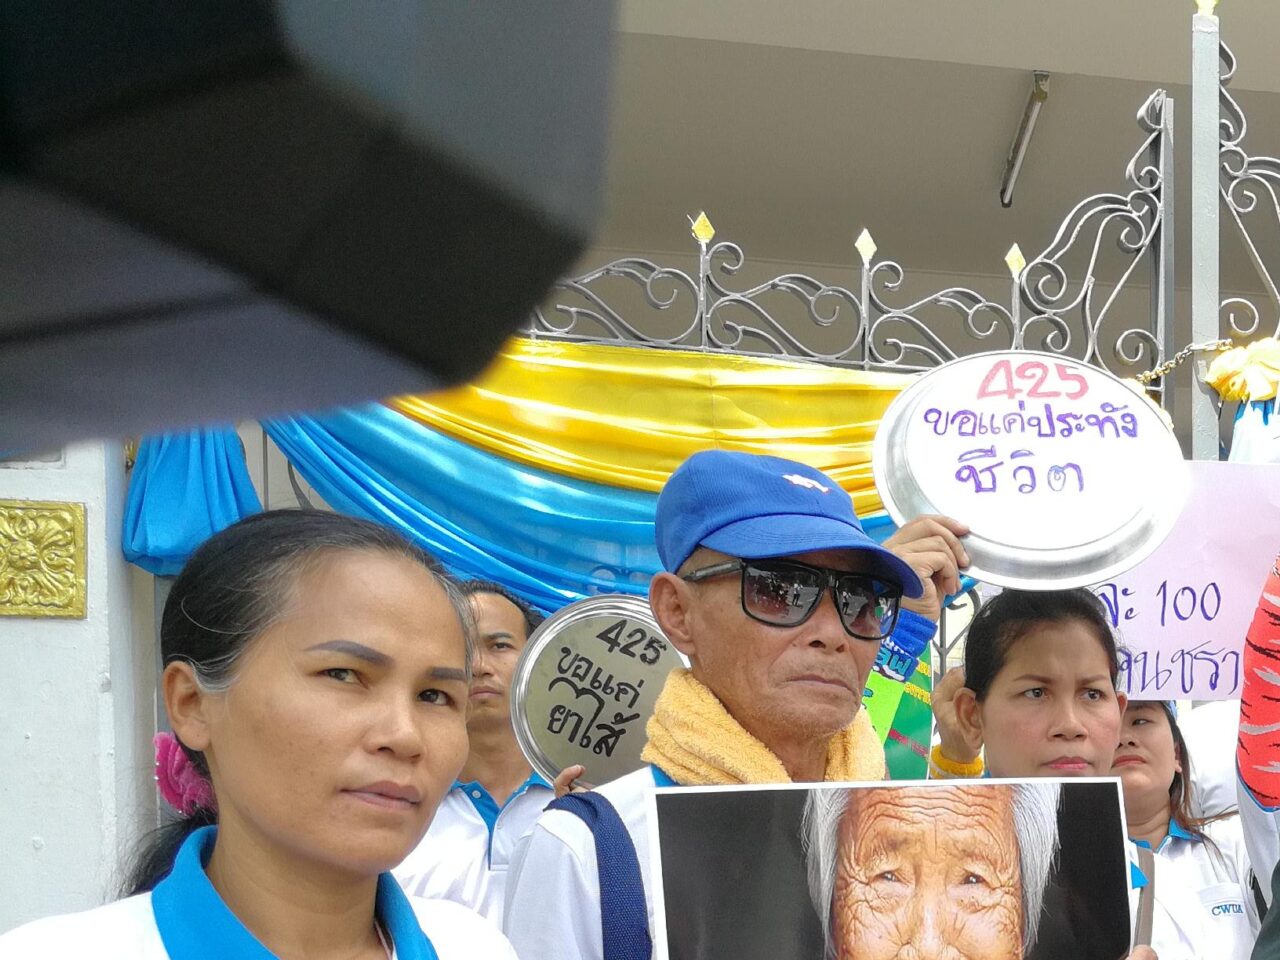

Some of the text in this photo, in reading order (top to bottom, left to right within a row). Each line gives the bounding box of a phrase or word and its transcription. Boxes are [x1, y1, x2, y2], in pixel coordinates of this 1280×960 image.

[976, 359, 1090, 400] 425
[922, 400, 1140, 440] ขอแค่ประทัง
[953, 445, 1086, 494] ชีวิต
[1156, 579, 1222, 626] 100
[595, 618, 668, 667] 425
[556, 645, 646, 709] ขอแค่
[546, 676, 641, 758] ยาไส้
[1211, 903, 1244, 917] CWUA
